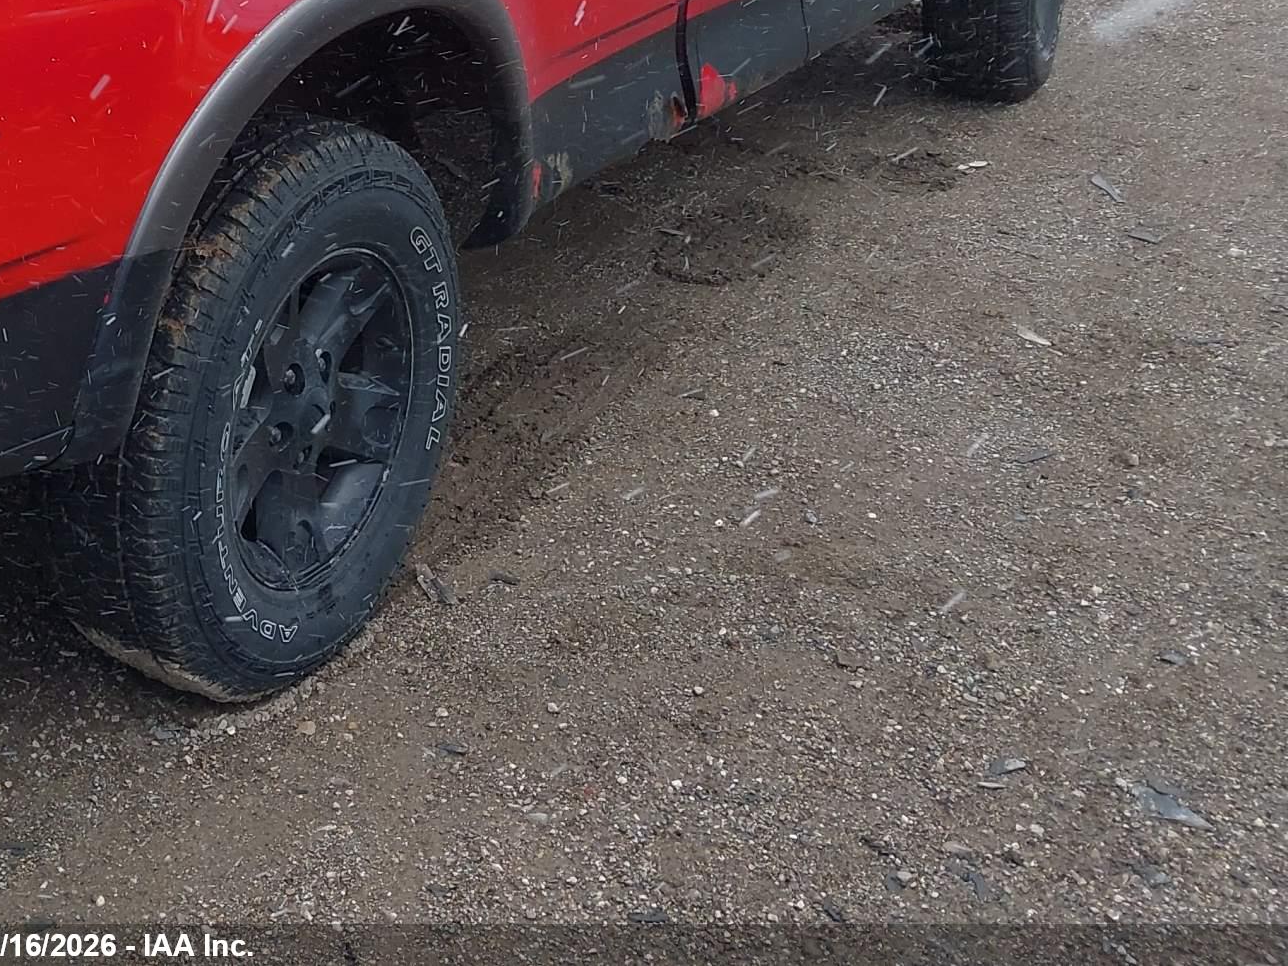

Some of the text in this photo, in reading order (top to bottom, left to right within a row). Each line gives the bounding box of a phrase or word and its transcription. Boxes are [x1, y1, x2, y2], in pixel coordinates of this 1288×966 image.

[409, 225, 454, 452] GT RADIAL
[214, 420, 299, 644] ADVENTURO
